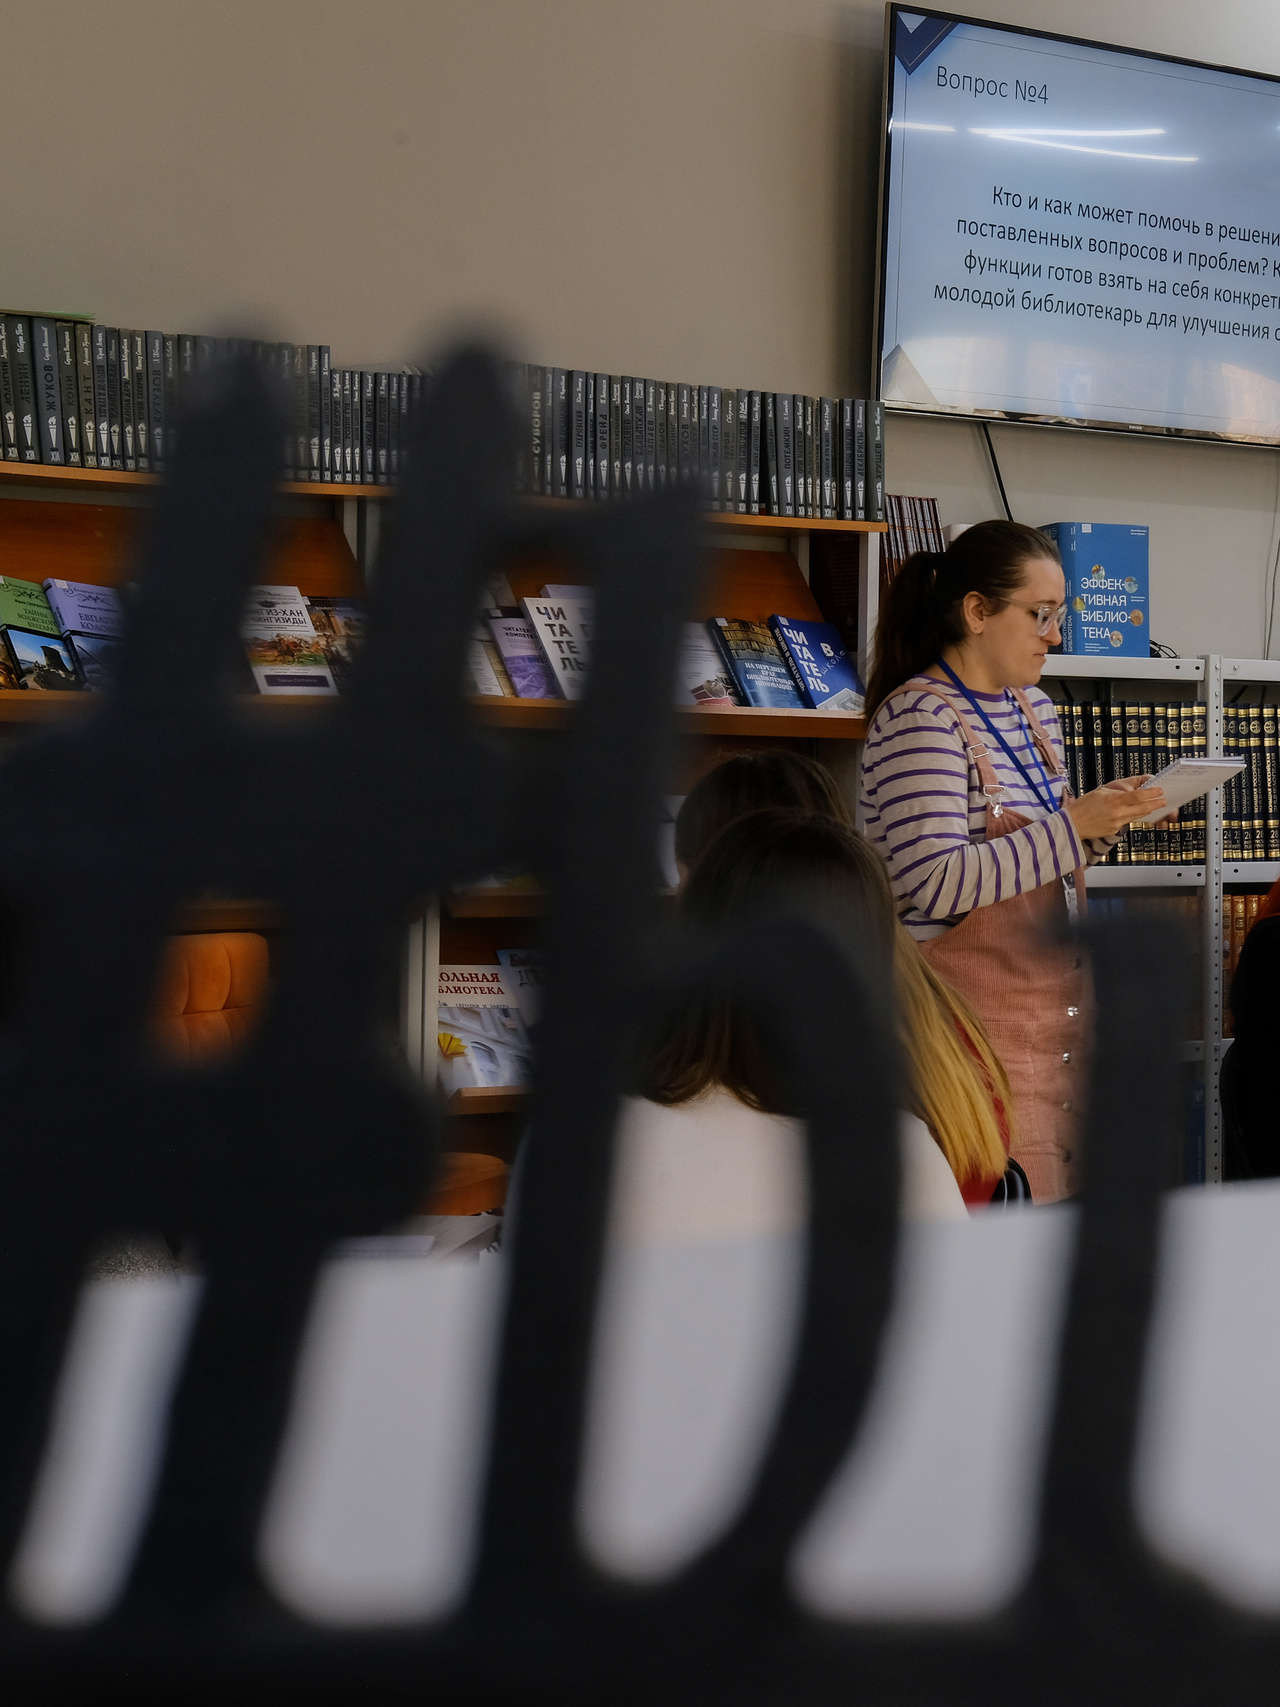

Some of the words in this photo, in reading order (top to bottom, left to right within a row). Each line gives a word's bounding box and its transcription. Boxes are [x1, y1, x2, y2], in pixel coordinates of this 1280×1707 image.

[936, 65, 1009, 98] Вопрос
[1014, 79, 1049, 105] №4
[992, 185, 1022, 209] Кто
[1028, 195, 1039, 211] и
[1044, 197, 1073, 216] как
[1077, 202, 1133, 226] может
[1138, 211, 1201, 235] помочь
[1205, 222, 1214, 237] в
[956, 218, 1083, 251] поставленных
[1088, 237, 1168, 262] вопросов
[1172, 249, 1183, 264] и
[1187, 251, 1269, 276] проблем?
[963, 249, 1042, 280] функции
[1048, 264, 1093, 285] готов
[1098, 271, 1143, 292] взять
[1148, 278, 1167, 295] на
[1172, 279, 1209, 300] себя
[933, 284, 1016, 310] молодой
[1021, 290, 1143, 326] библиотекарь
[1146, 311, 1177, 330] для
[1182, 315, 1270, 340] улучшения
[18, 363, 31, 404] ЛЕНИН
[44, 364, 57, 411] ЖУКОВ
[65, 374, 75, 407] КОНИ
[83, 374, 93, 415] КАНТ
[152, 369, 162, 423] КУТУЗОВ
[531, 391, 542, 454] СУВОРОВ
[598, 413, 608, 450] ФРЕЙД
[624, 418, 632, 457] БЕРДЯЕВ
[635, 405, 644, 456] БЛАВАТСКАЯ
[647, 419, 655, 456] ЧАПАЕВ
[783, 426, 792, 470] ПОТЕМКИН
[875, 442, 883, 479] ХРУЩЕВ
[1080, 576, 1125, 591] ЭФФЕК-
[1080, 593, 1127, 607] ТИВНАЯ
[535, 606, 567, 621] ЧИ
[544, 623, 574, 637] ТА
[1080, 610, 1132, 623] БИБЛИО-
[553, 640, 580, 655] ТЕ
[782, 627, 809, 646] ЧИ
[819, 642, 835, 657] В
[1081, 626, 1111, 639] ТЕКА
[560, 657, 586, 671] ЛЬ
[791, 644, 815, 661] ТА
[799, 660, 822, 677] ТЕ
[787, 656, 806, 692] ЧИТАТЕЛЬ
[807, 677, 831, 693] ЛЬ
[1133, 832, 1142, 841] 17
